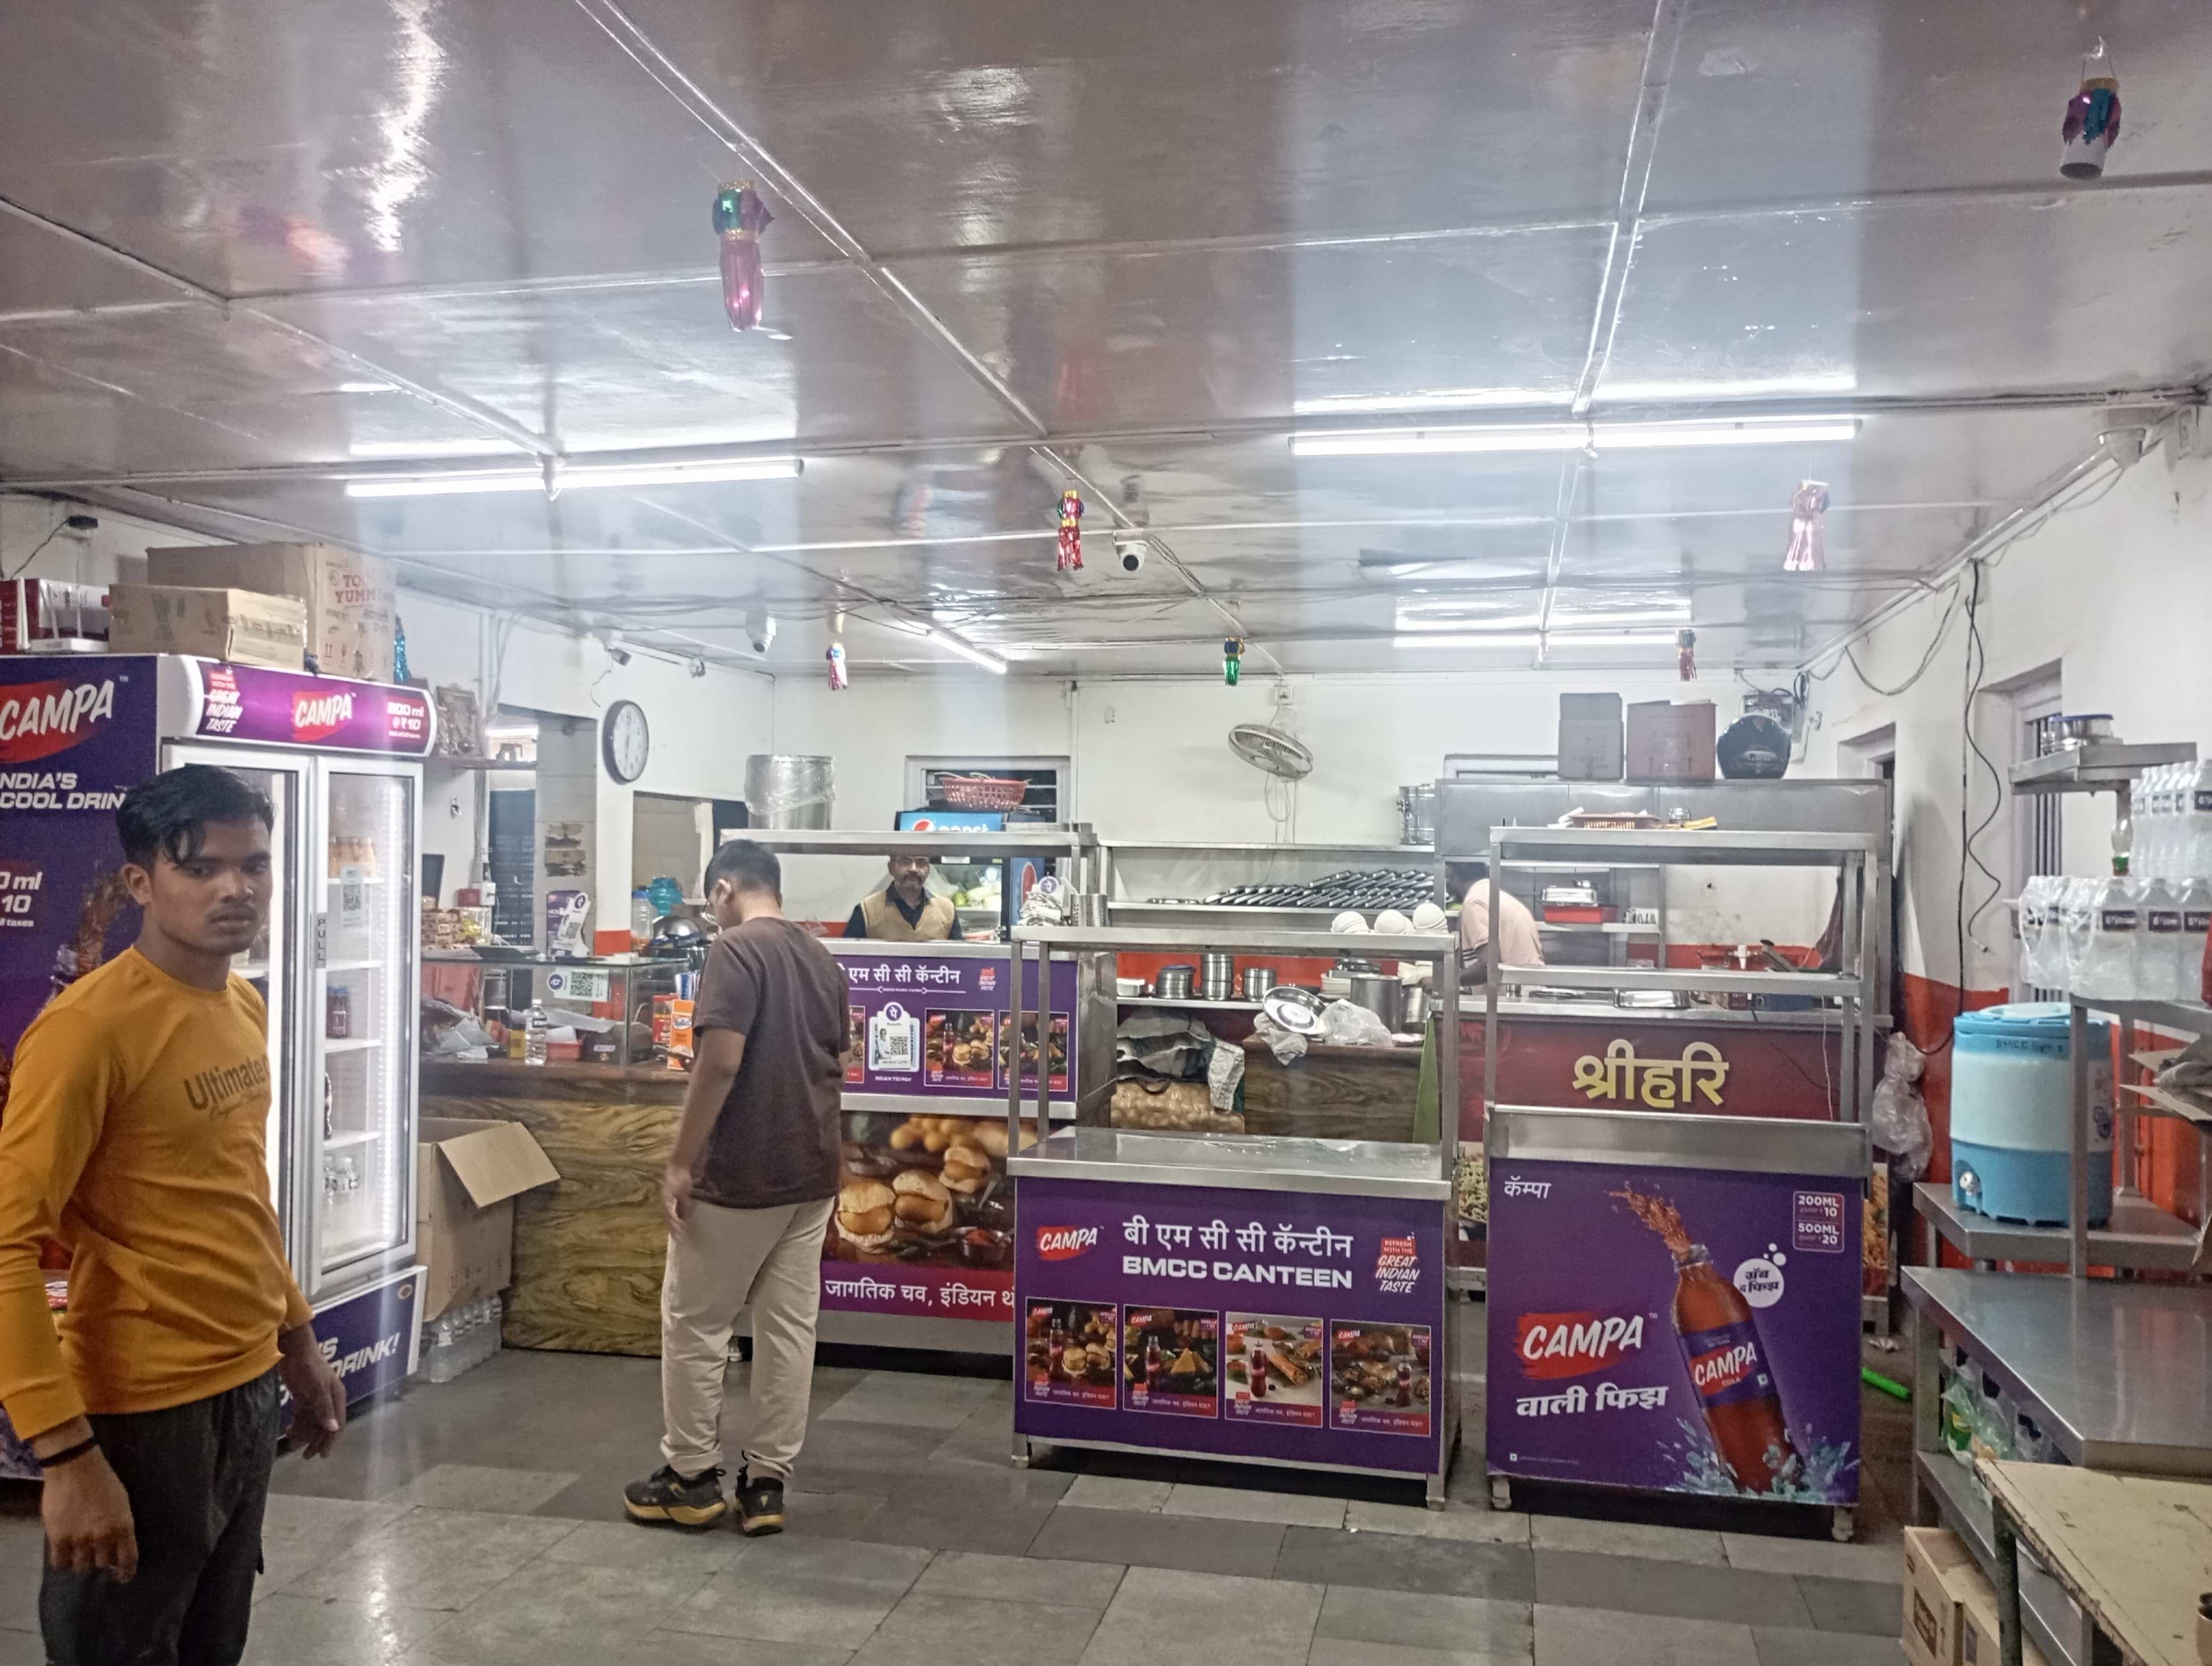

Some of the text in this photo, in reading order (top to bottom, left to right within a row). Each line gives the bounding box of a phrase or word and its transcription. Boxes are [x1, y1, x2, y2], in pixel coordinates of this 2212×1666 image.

[0, 680, 114, 740] CAMPA
[295, 694, 352, 728] CAMPA
[0, 773, 78, 790] NDIA'S
[0, 792, 126, 810] COOL DRIN
[12, 871, 43, 890] ml
[318, 918, 326, 961] PULL
[848, 964, 961, 984] एम सी सी कॅन्टीन
[1572, 1038, 1729, 1108] श्रीहरि
[1504, 1175, 1552, 1200] कॅम्पा
[1798, 1195, 1840, 1208] 200ML
[1824, 1207, 1838, 1218] 10
[1040, 1227, 1098, 1251] CAMPA
[1122, 1215, 1354, 1258] बी एम सी सी कॅन्टीन
[1798, 1223, 1840, 1235] 500ML
[1822, 1234, 1838, 1245] 20
[1123, 1255, 1353, 1289] BMCC CANTEEN
[1378, 1254, 1418, 1267] GREAT
[1375, 1266, 1420, 1280] INDIAN
[825, 1276, 896, 1300] जागतिक
[901, 1285, 933, 1307] चव,
[940, 1281, 996, 1308] इंडियन
[1380, 1280, 1416, 1293] TASTE
[1523, 1315, 1644, 1360] CAMPA
[1695, 1341, 1758, 1386] CAMPA
[1516, 1382, 1669, 1417] वाली फिझ
